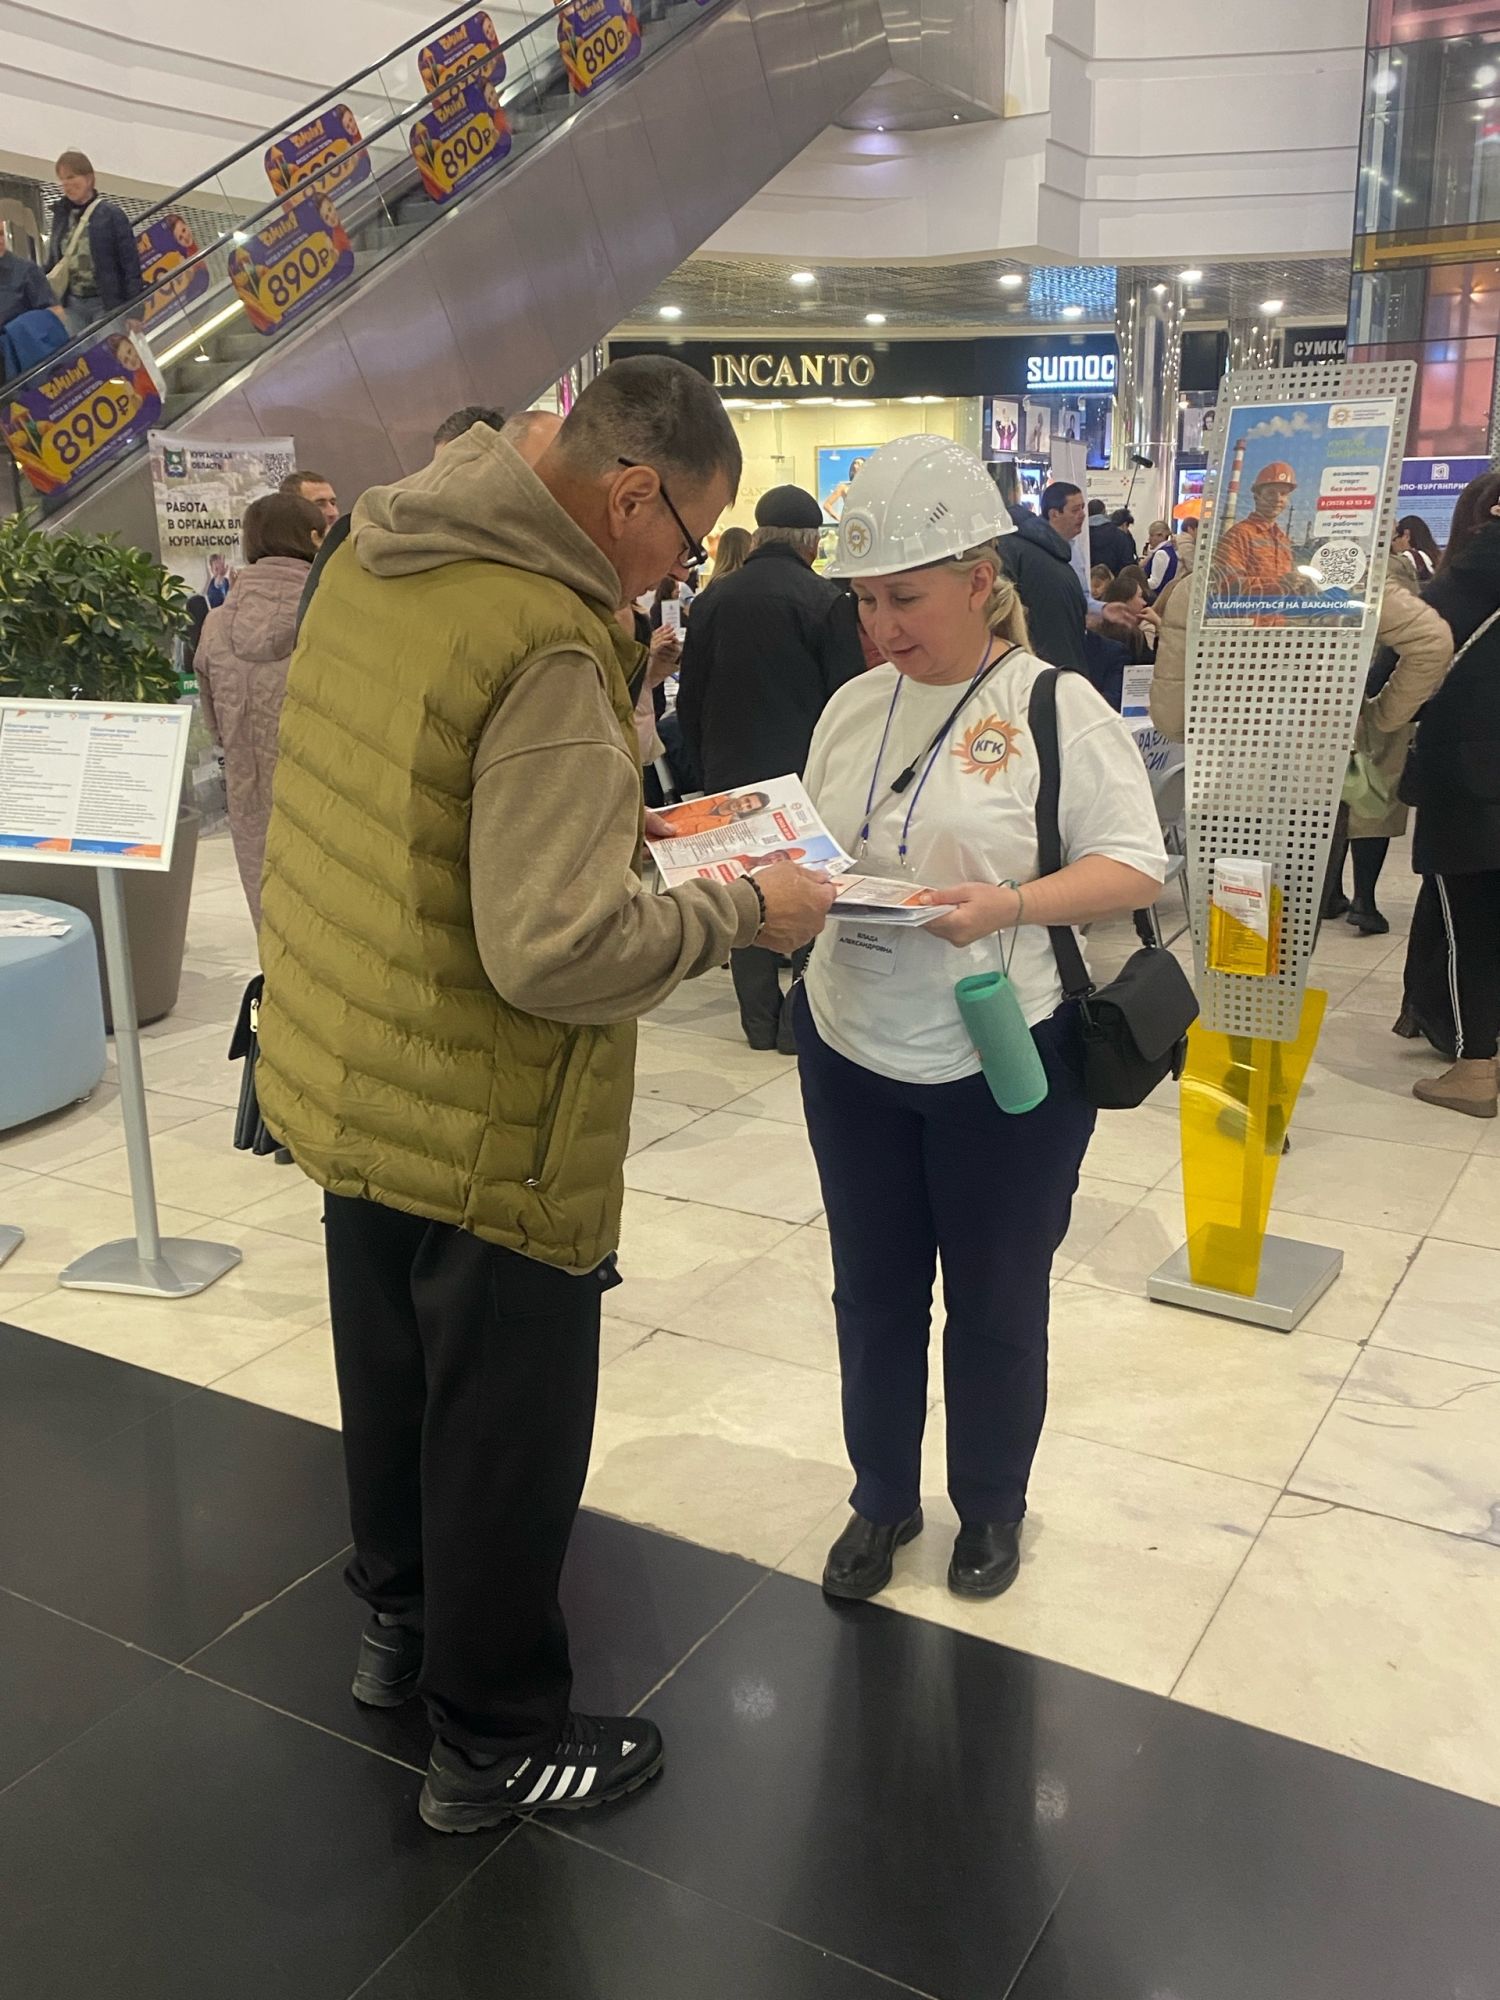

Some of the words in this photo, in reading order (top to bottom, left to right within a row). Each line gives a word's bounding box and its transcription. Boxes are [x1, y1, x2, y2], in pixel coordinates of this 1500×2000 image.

[1294, 340, 1345, 356] СУМКИ
[712, 354, 875, 387] INCANTO
[190, 451, 232, 459] КУРГАНСКАЯ
[191, 462, 222, 470] ОБЛАСТЬ
[166, 502, 208, 513] РАБОТА
[168, 520, 175, 529] В
[178, 519, 226, 529] ОРГАНАХ
[228, 519, 241, 529] ВЛ
[169, 533, 240, 547] КУРГАНСКОЙ
[1211, 600, 1284, 609] ОТКЛИКНУТЬСЯ
[1285, 600, 1300, 609] НА
[974, 740, 1004, 754] КГК
